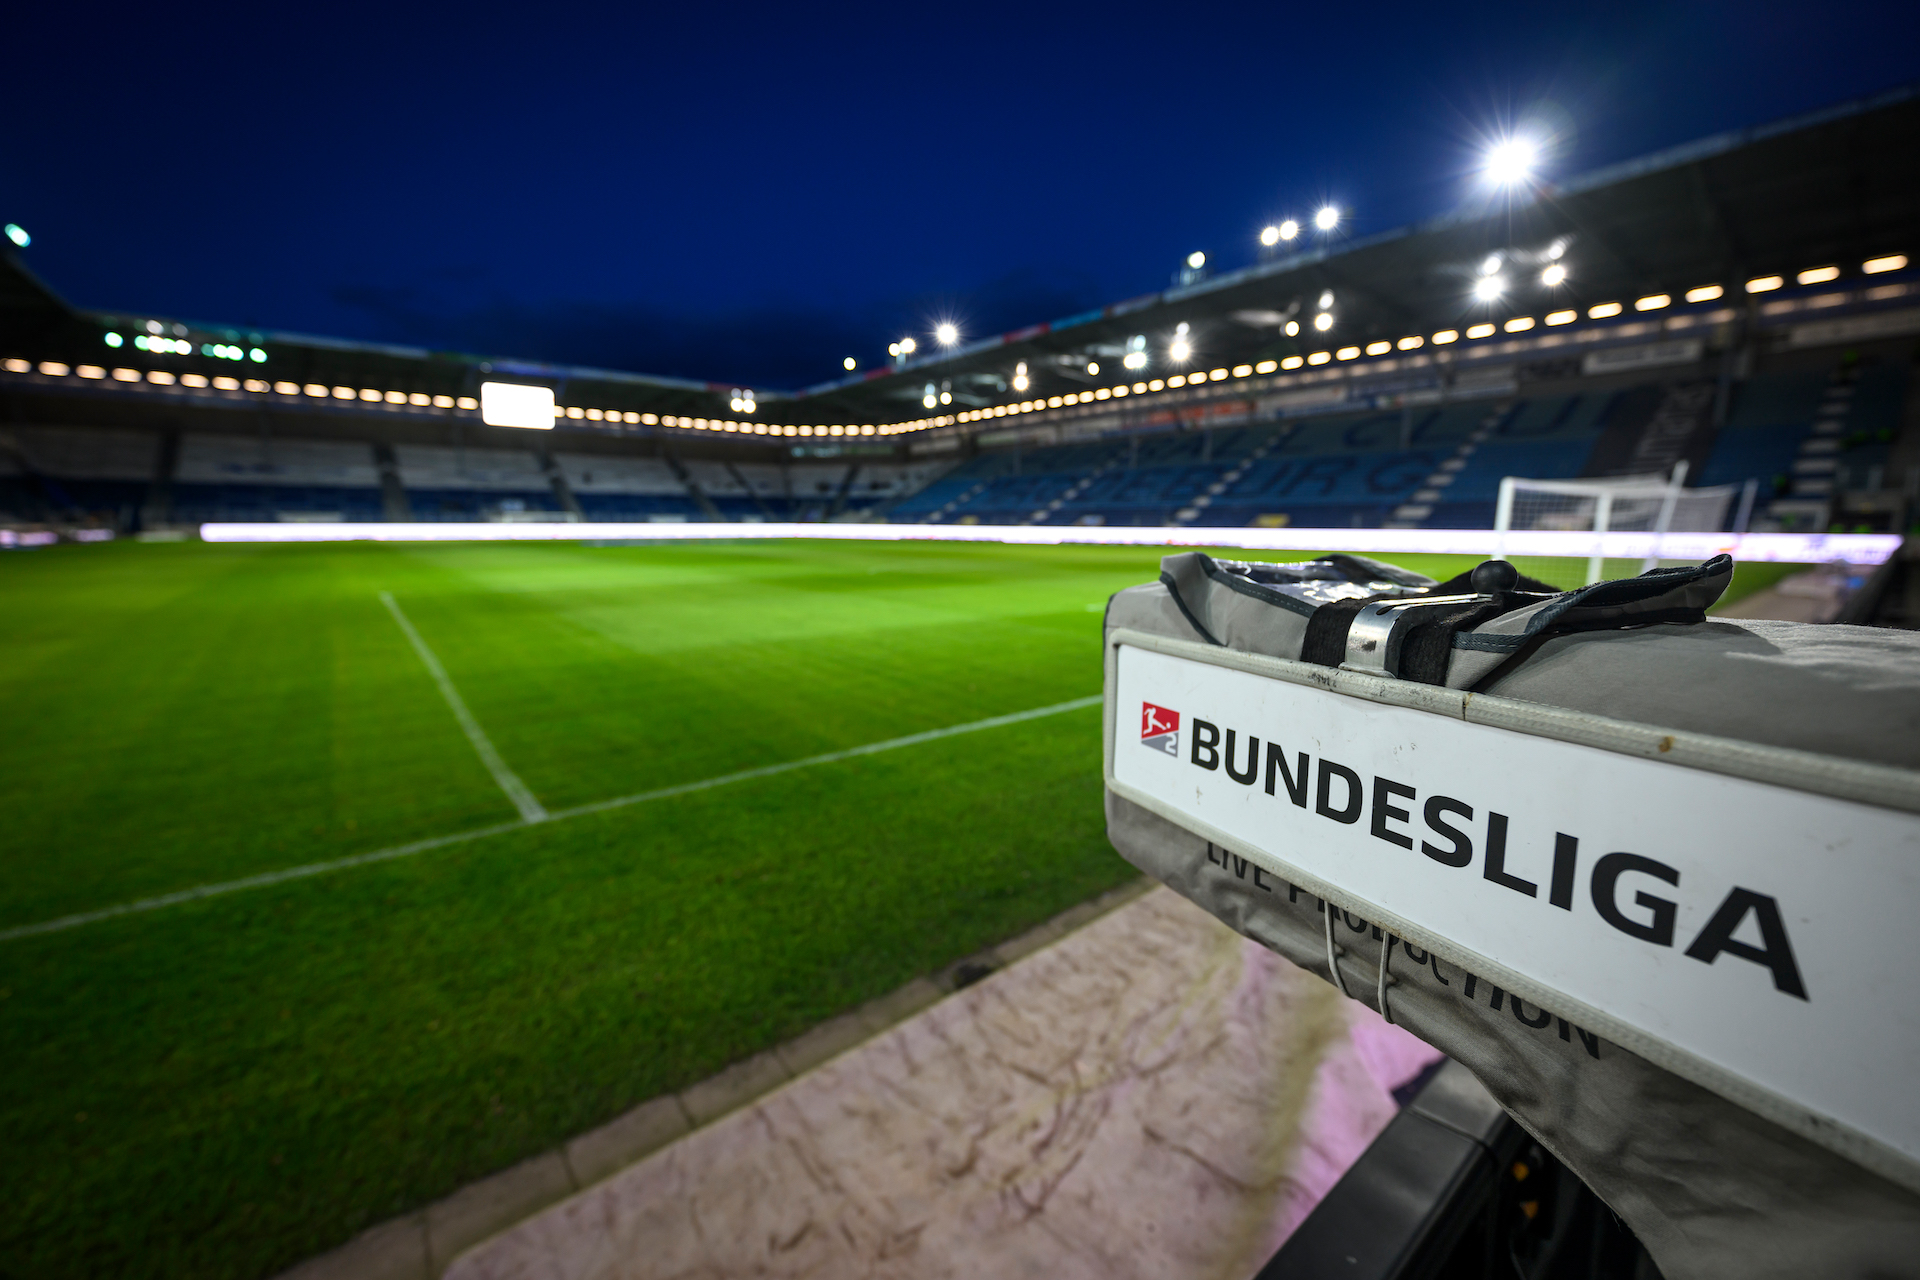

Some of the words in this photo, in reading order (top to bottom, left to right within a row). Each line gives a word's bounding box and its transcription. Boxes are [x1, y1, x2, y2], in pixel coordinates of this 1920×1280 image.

[1165, 732, 1177, 755] 2
[1191, 718, 1811, 1003] BUNDESLIGA
[1207, 841, 1272, 892] LIVE
